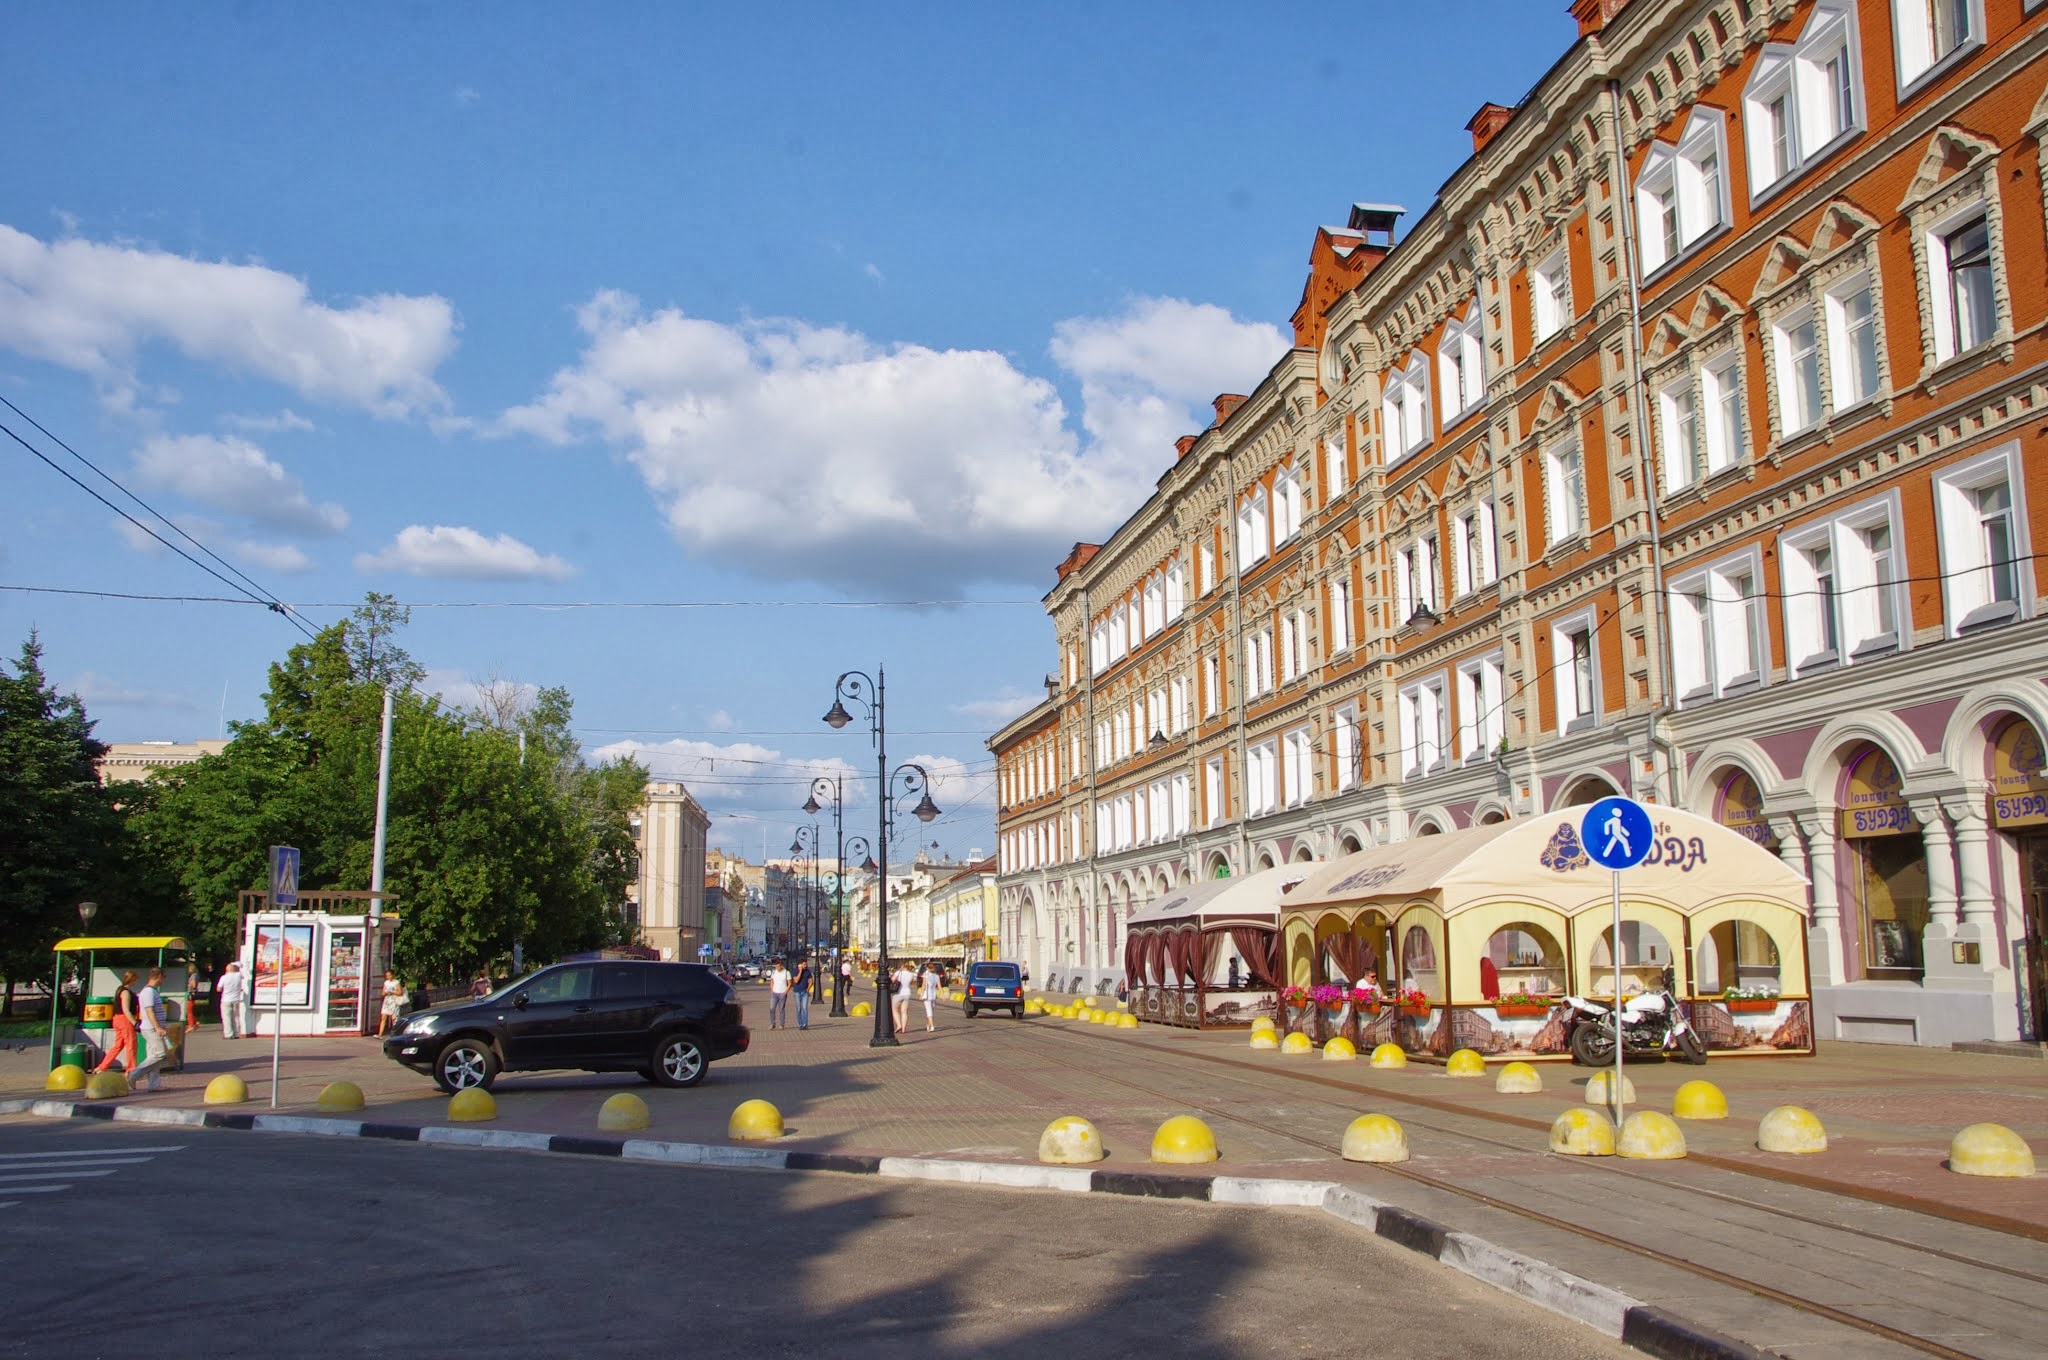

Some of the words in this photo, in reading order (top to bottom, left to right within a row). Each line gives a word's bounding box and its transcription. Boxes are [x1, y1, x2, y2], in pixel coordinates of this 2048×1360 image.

[1854, 806, 1911, 832] БУДДА
[1996, 794, 2048, 820] БУДД
[1641, 836, 1707, 873] ДДА
